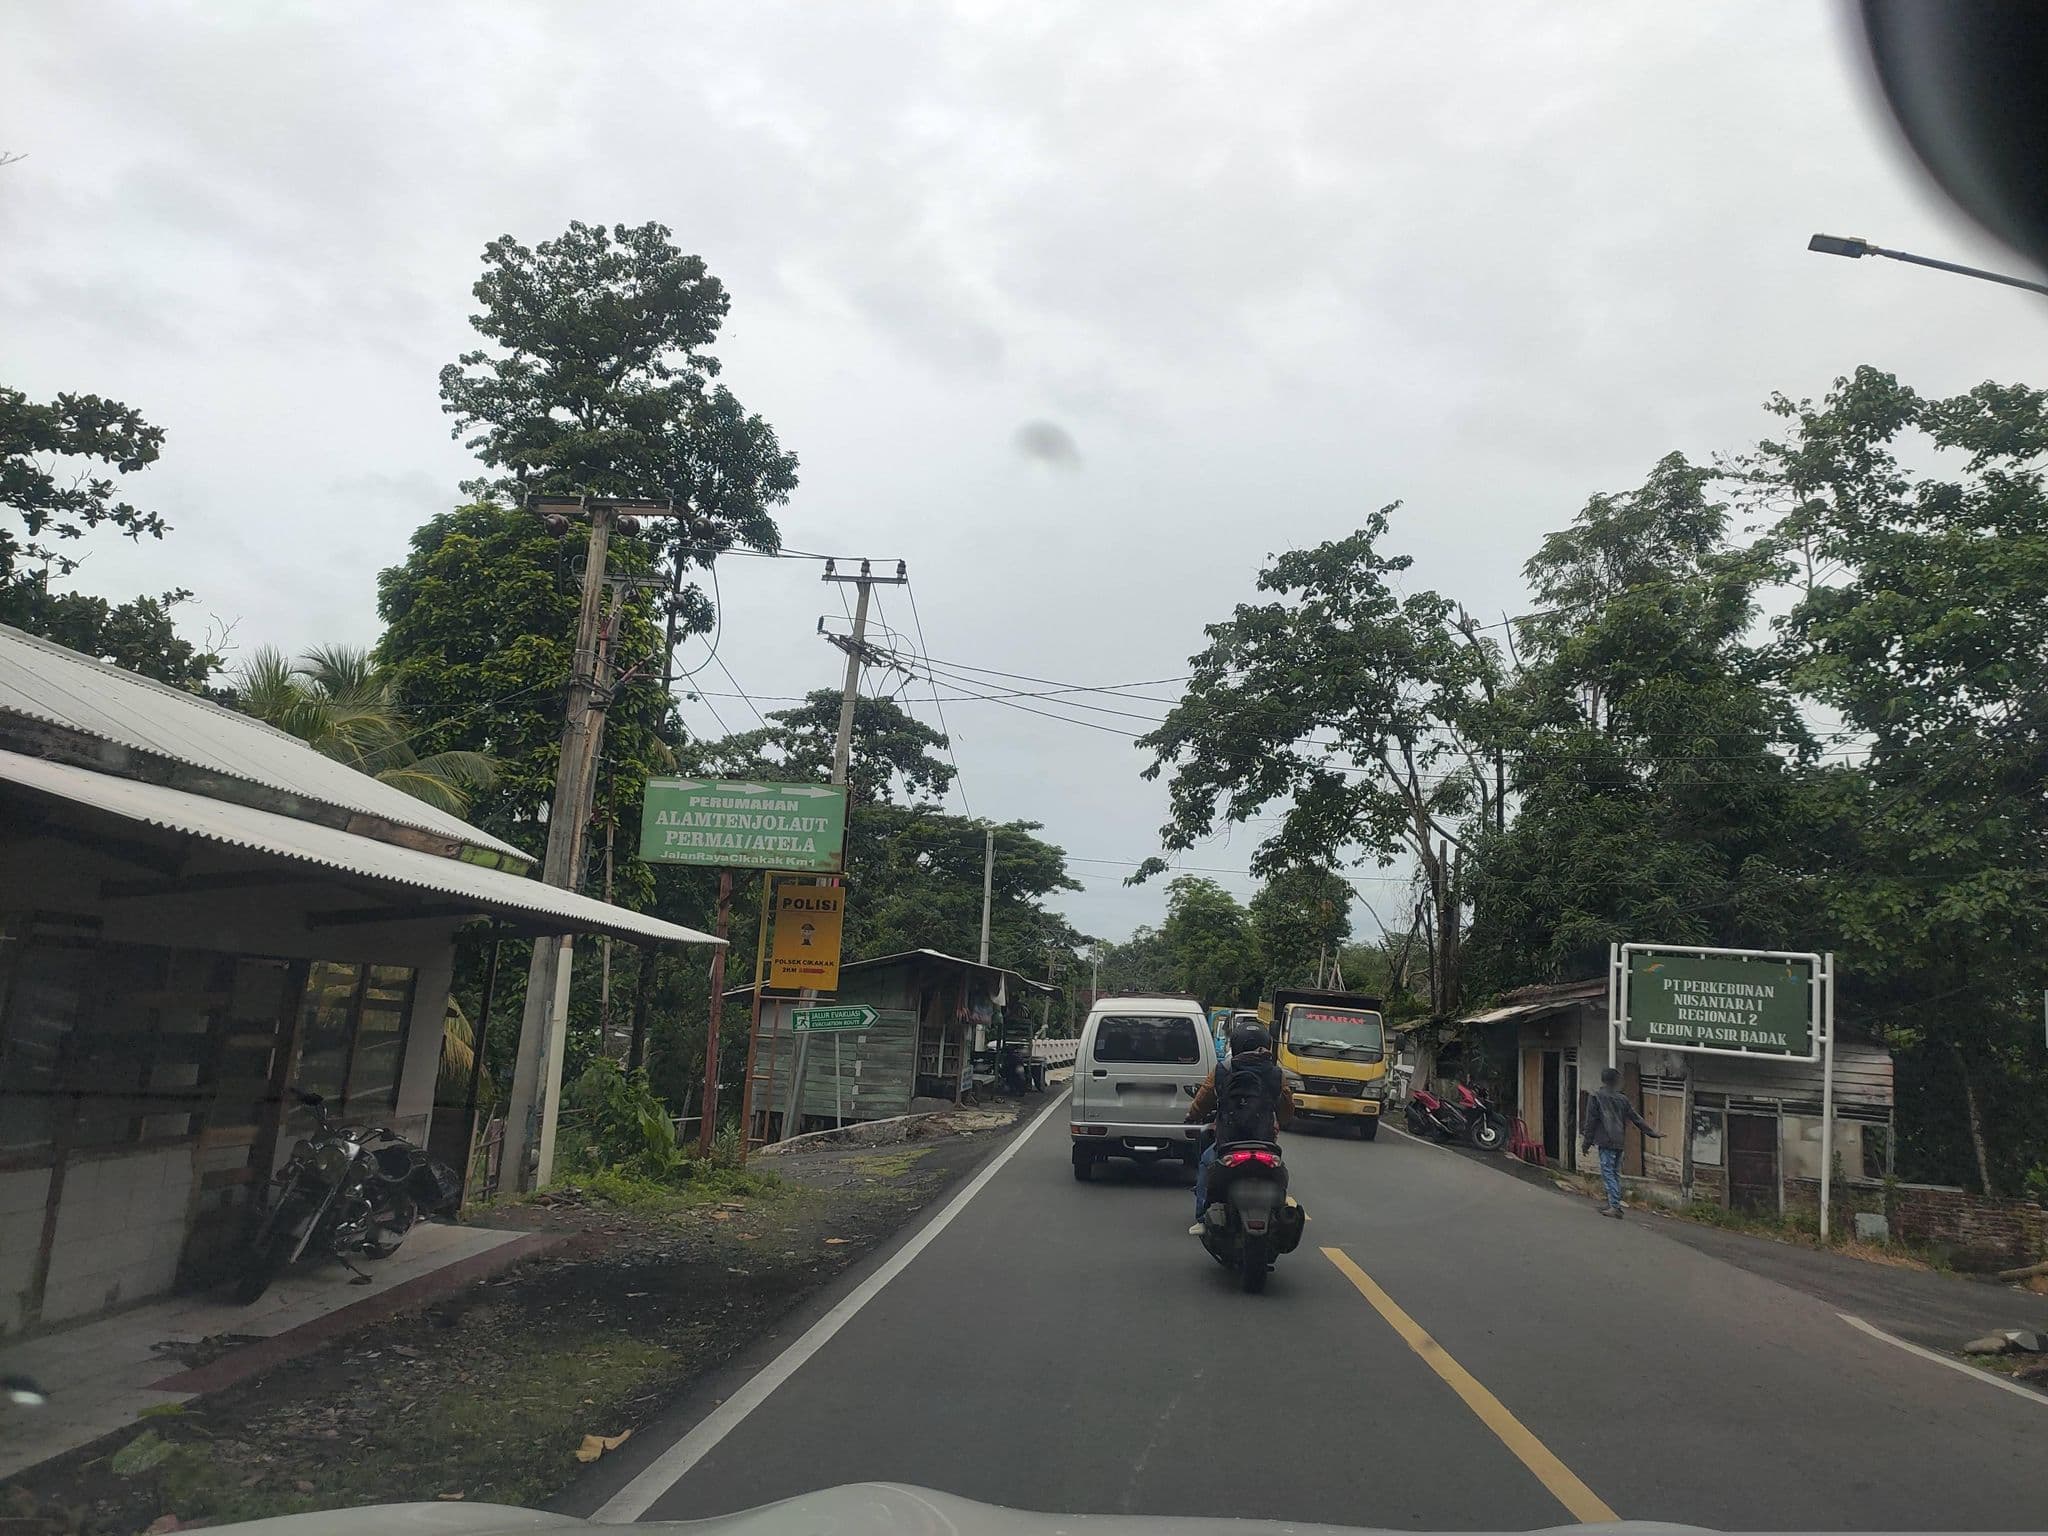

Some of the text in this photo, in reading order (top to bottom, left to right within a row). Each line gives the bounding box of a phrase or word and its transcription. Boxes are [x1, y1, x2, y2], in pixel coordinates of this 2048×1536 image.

[689, 796, 799, 812] PERUMAHAN
[664, 830, 817, 853] PERMAI/ATELA
[782, 897, 837, 911] POLISI
[774, 958, 801, 966] POLSEK
[1663, 978, 1774, 998] PT PERKEBUNAN
[1674, 994, 1755, 1011] NUSANTARA
[811, 1010, 861, 1020] JALUR EVAKUASI
[1678, 1008, 1758, 1026] REGIONAL 2
[1649, 1022, 1788, 1046] KEBUN PASIR BADAK
